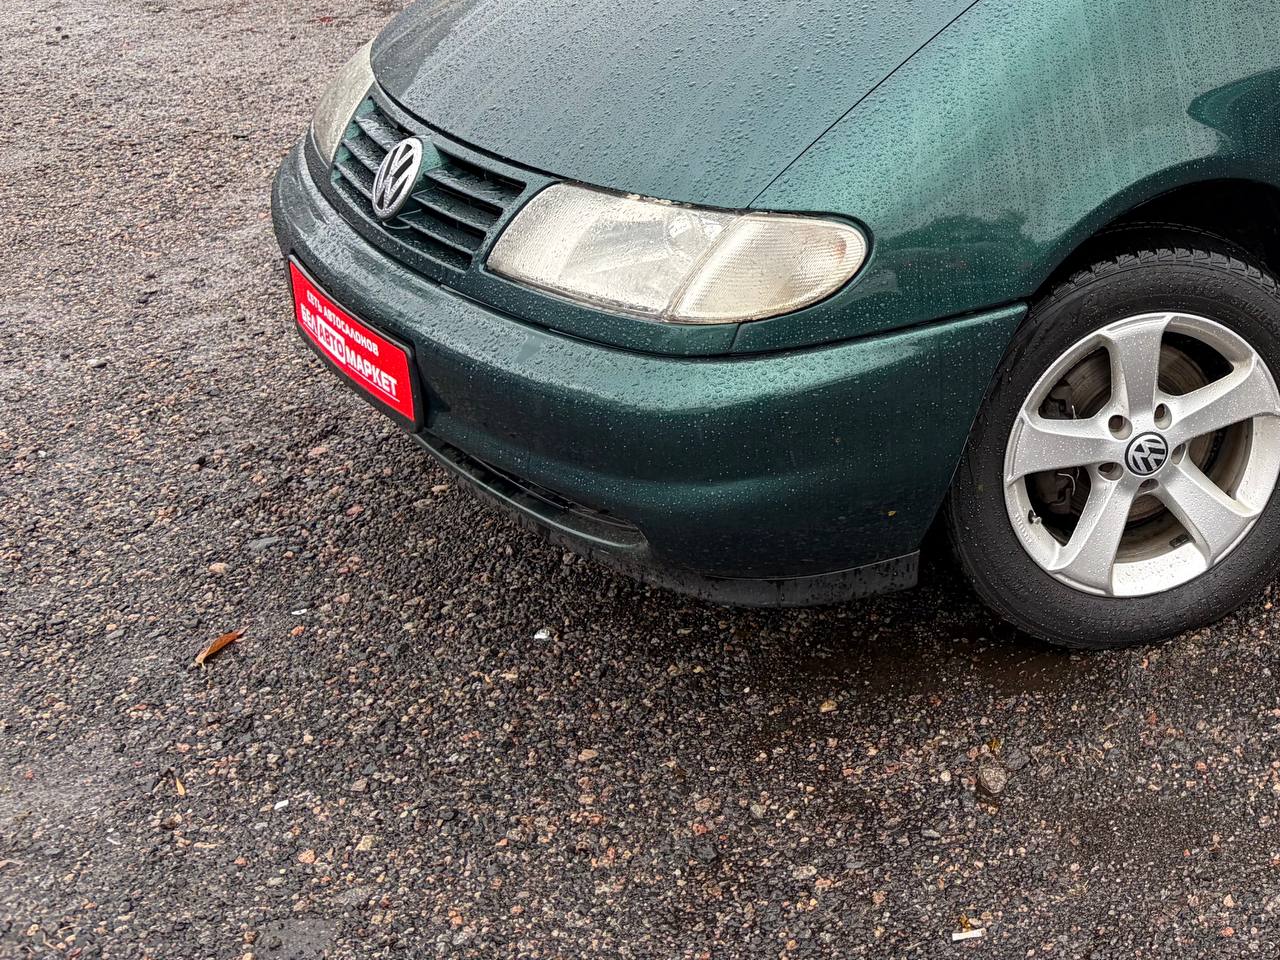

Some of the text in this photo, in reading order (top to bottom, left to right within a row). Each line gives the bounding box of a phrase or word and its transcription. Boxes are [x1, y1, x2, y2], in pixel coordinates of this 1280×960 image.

[300, 303, 398, 396] БЕЛ АВТО МАРКЕТ
[306, 290, 379, 357] СЕТЬ АВТОСАЛОНОВ
